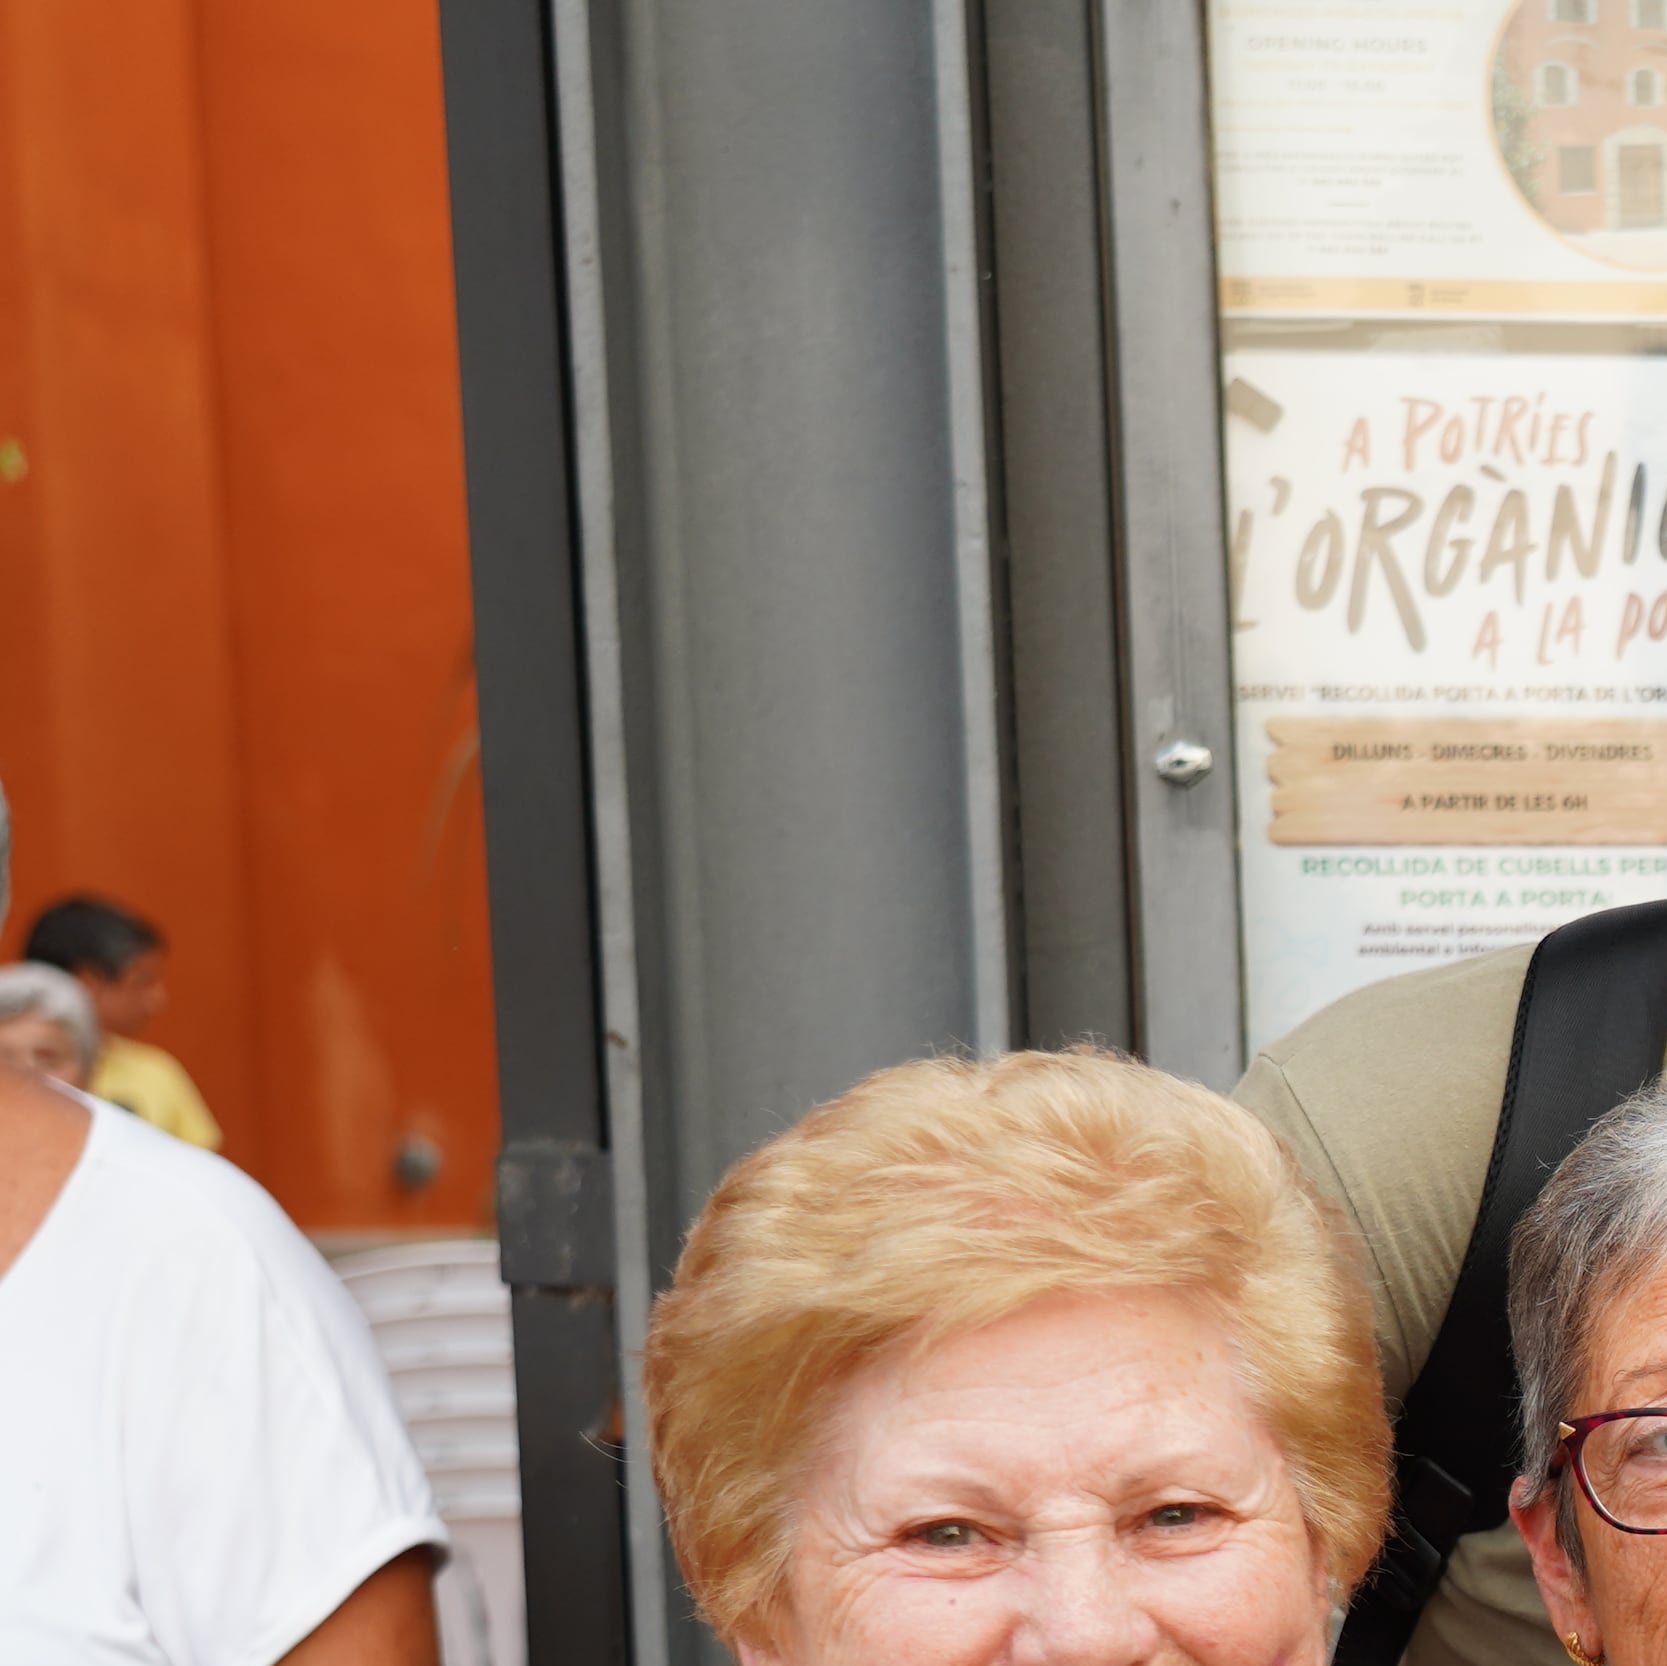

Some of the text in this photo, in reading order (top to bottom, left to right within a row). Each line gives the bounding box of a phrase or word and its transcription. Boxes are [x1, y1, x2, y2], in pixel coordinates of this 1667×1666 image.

[1342, 416, 1372, 473] A
[1471, 608, 1503, 671] A
[1535, 594, 1589, 668] LA
[1238, 684, 1307, 703] SERVEI
[1433, 684, 1498, 702] PORTA
[1504, 684, 1518, 702] A
[1523, 684, 1587, 702] PORTA
[1595, 685, 1618, 702] DE
[1332, 742, 1655, 762] DILLUNS DIMECRES DIVENDRES
[1402, 794, 1589, 812] A PARTIR DE LES 6H
[1302, 855, 1447, 878] RECOLLIDA
[1454, 856, 1489, 877] DE
[1498, 855, 1612, 877] CUBELLS
[1400, 889, 1487, 910] PORTA
[1494, 890, 1514, 910] A
